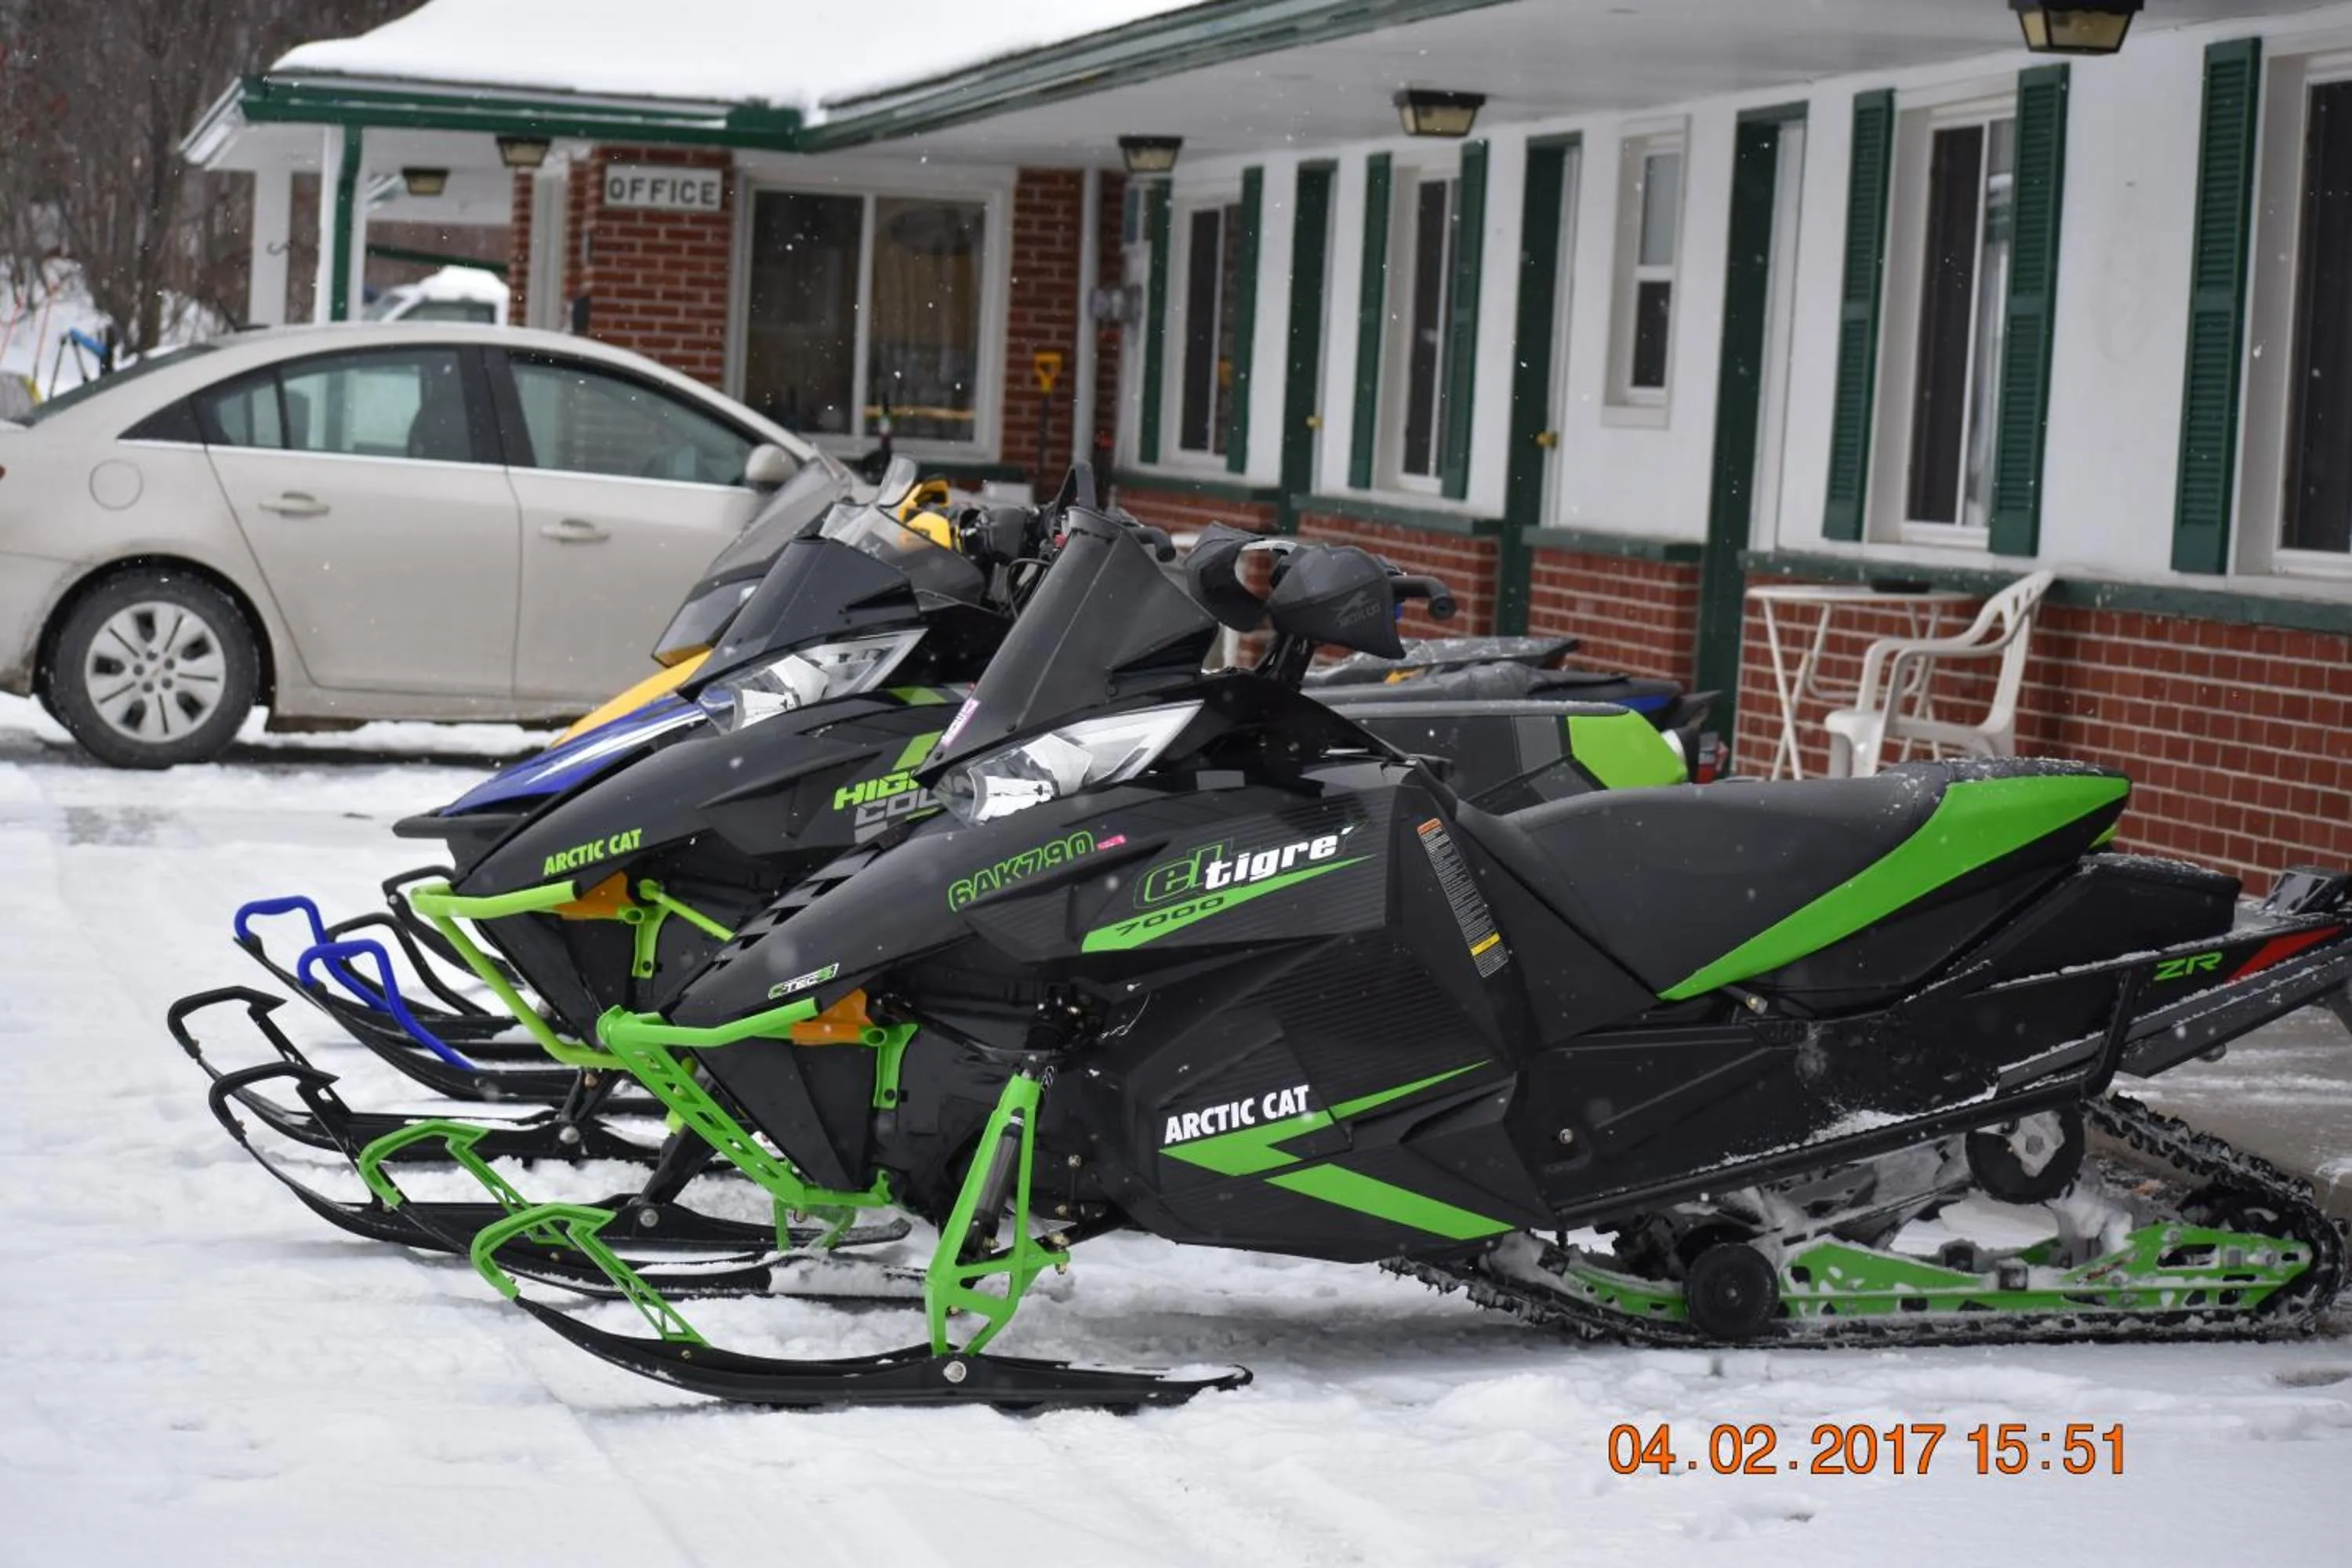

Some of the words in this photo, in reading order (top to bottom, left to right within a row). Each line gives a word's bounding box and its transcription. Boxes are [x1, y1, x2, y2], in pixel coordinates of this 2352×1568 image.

[608, 176, 717, 205] OFFICE
[543, 839, 604, 877] ARCTIC
[608, 827, 642, 855] CAT
[948, 830, 1095, 913] 6AK790
[1115, 896, 1225, 937] 7000
[2153, 951, 2223, 982] ZR
[1164, 1098, 1255, 1145] ARCTIC
[1262, 1084, 1309, 1120] CAT
